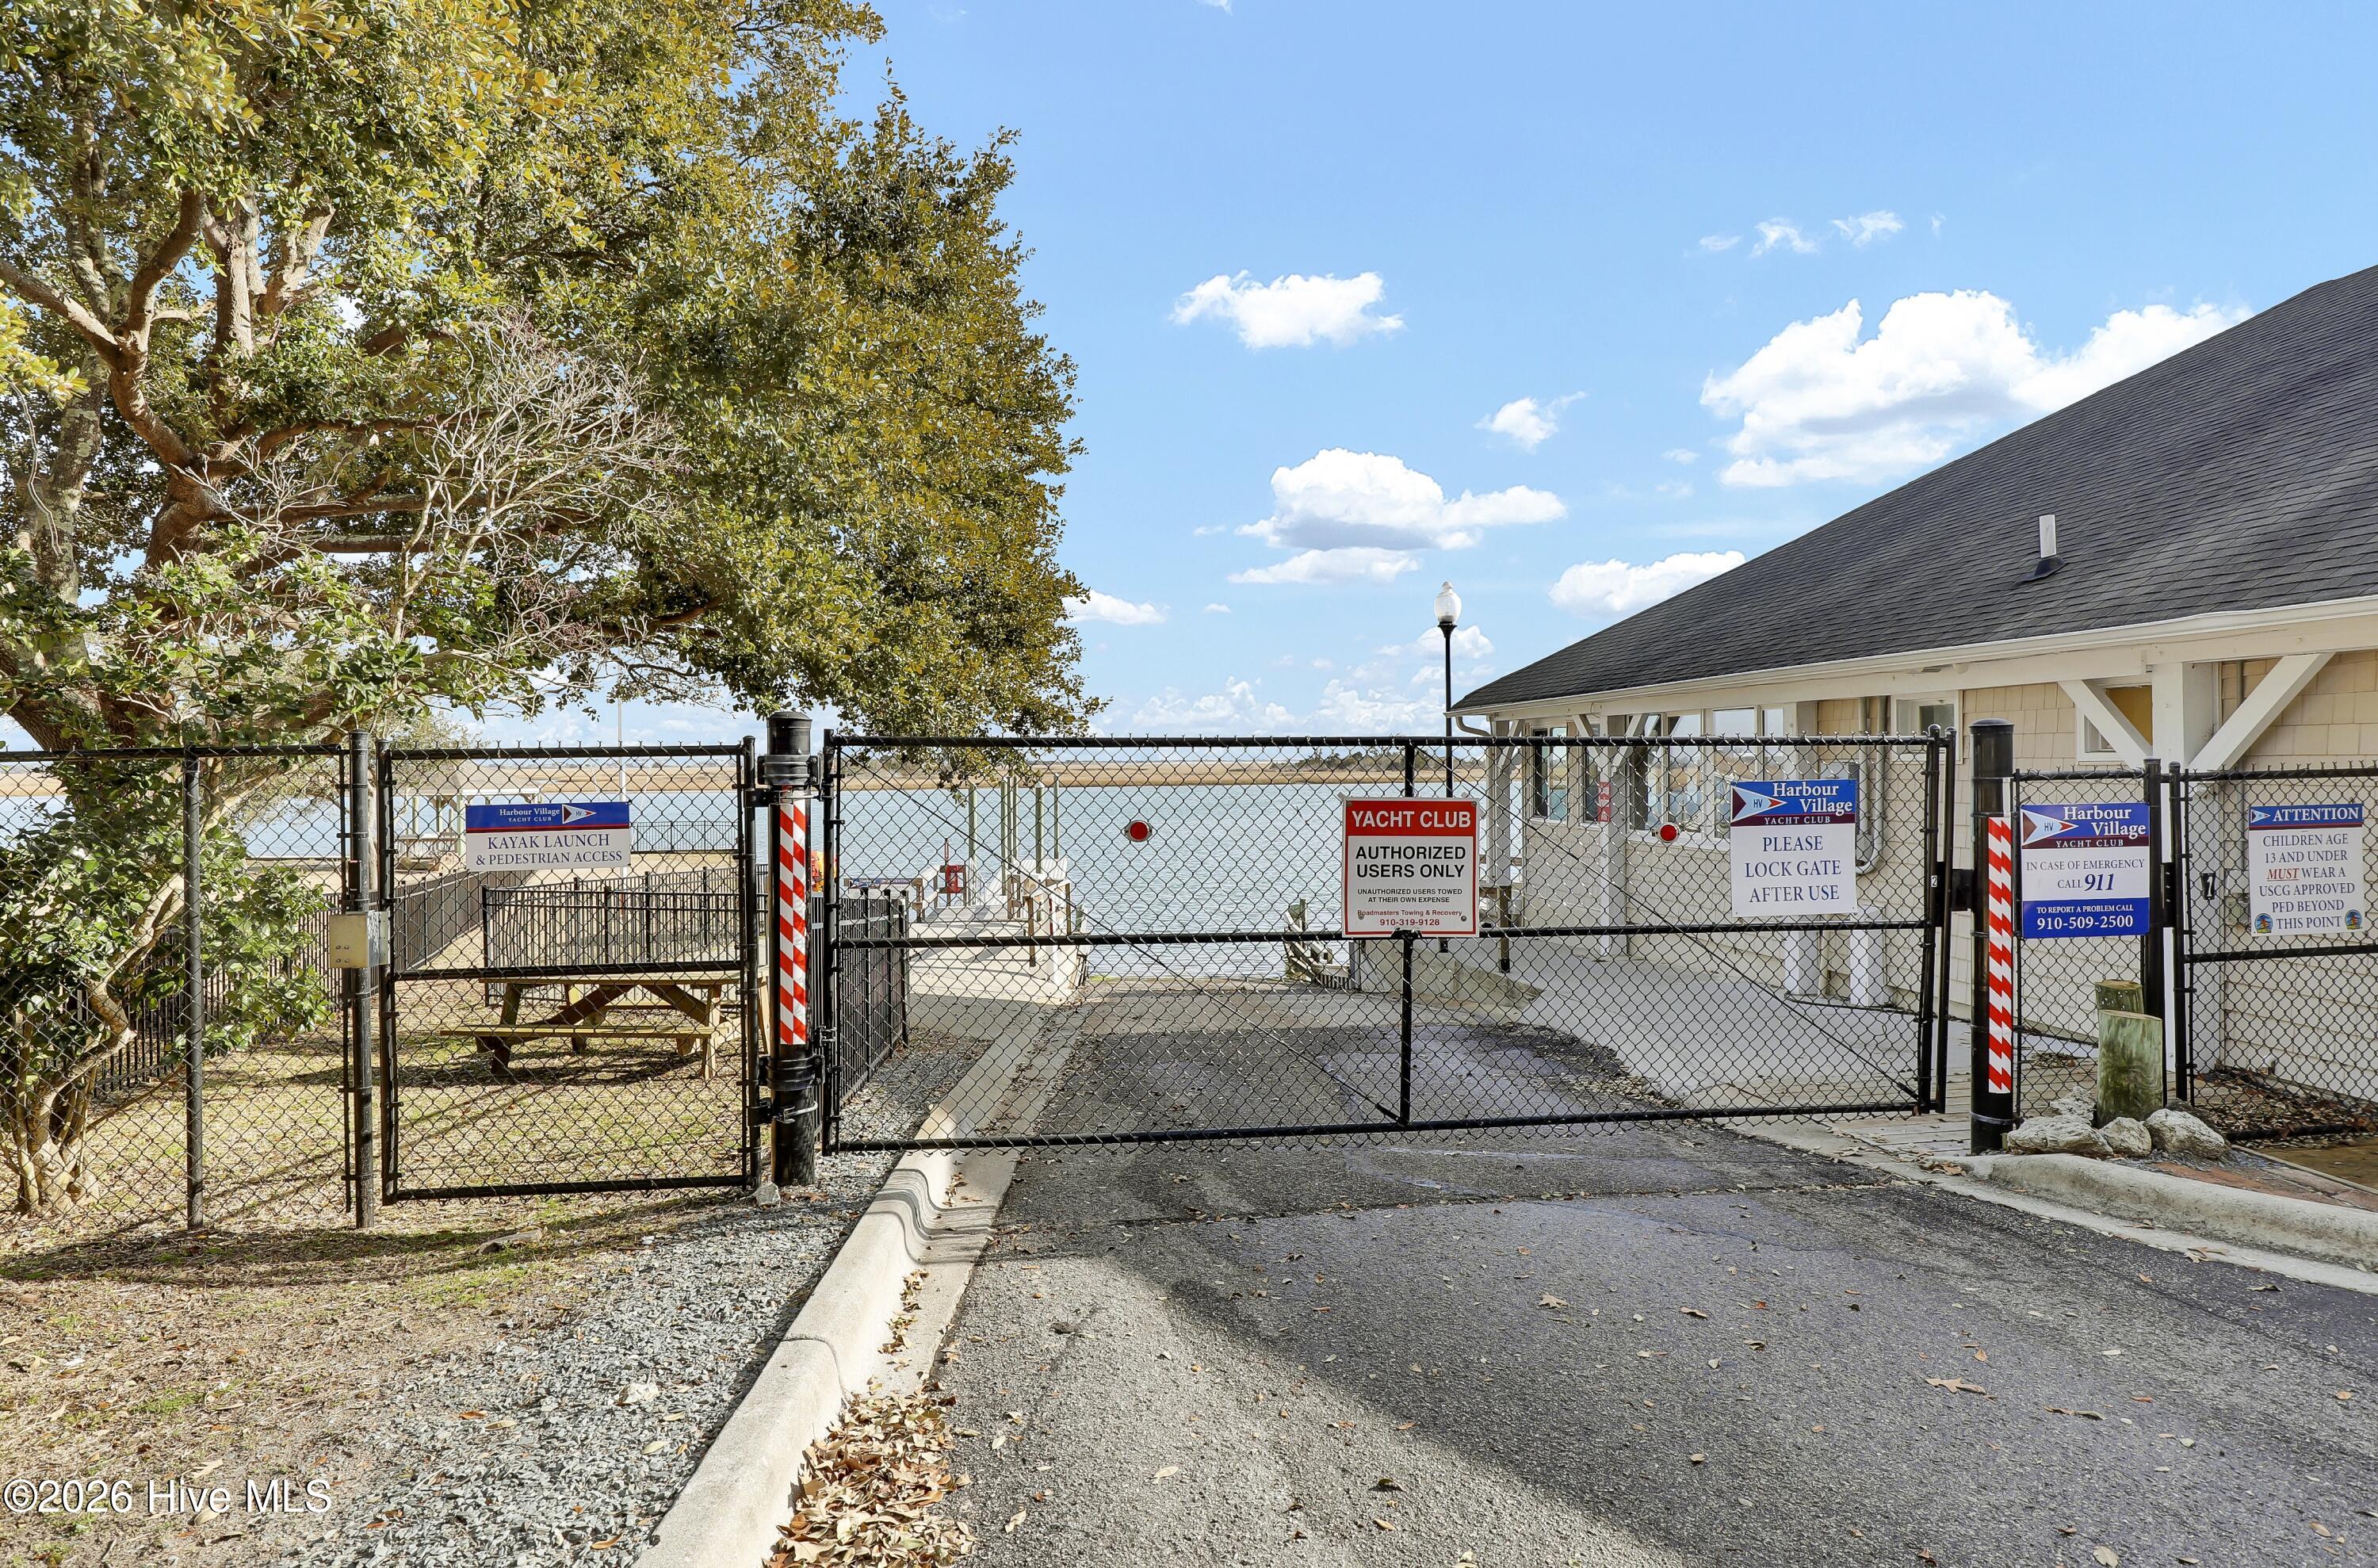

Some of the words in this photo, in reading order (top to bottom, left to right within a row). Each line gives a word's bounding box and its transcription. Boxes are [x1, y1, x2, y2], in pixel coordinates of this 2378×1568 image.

[1772, 782, 1839, 797] Harbour
[1753, 799, 1763, 808] HV
[1800, 799, 1852, 816] Village
[534, 808, 560, 817] Village
[1351, 810, 1414, 828] YACHT
[1420, 811, 1470, 828] CLUB
[2063, 806, 2131, 820] Harbour
[2273, 807, 2358, 821] ATTENTION
[2091, 821, 2146, 839] Village
[487, 836, 539, 849] KAYAK
[544, 834, 610, 847] LAUNCH
[1763, 836, 1823, 851] PLEASE
[2263, 835, 2322, 847] CHILDREN
[2326, 834, 2348, 844] AGE
[489, 852, 570, 864] PEDESTRIAN
[574, 851, 621, 862] ACCESS
[1355, 846, 1466, 859] AUTHORIZED
[2265, 853, 2276, 862] 13
[2279, 851, 2303, 862] AND
[2307, 851, 2348, 862] UNDER
[1357, 864, 1414, 878] USERS
[1420, 864, 1464, 878] ONLY
[1745, 862, 1792, 877] LOCK
[1797, 860, 1841, 875] GATE
[2040, 862, 2064, 870] CASE
[2067, 861, 2081, 870] OF
[2083, 859, 2145, 869] EMERGENCY
[2267, 868, 2300, 879] MUST
[2302, 867, 2336, 878] WEAR
[2338, 866, 2346, 877] A
[2058, 879, 2082, 888] CALL
[2084, 874, 2114, 891] 911
[1749, 886, 1804, 902] AFTER
[1809, 885, 1839, 901] USE
[2259, 885, 2290, 897] USCG
[2293, 883, 2354, 895] APPROVED
[2273, 902, 2293, 912] PFD
[2297, 900, 2344, 912] BEYOND
[2037, 915, 2133, 930] 910-509-2500
[2277, 918, 2303, 929] THIS
[2306, 916, 2342, 928] POINT
